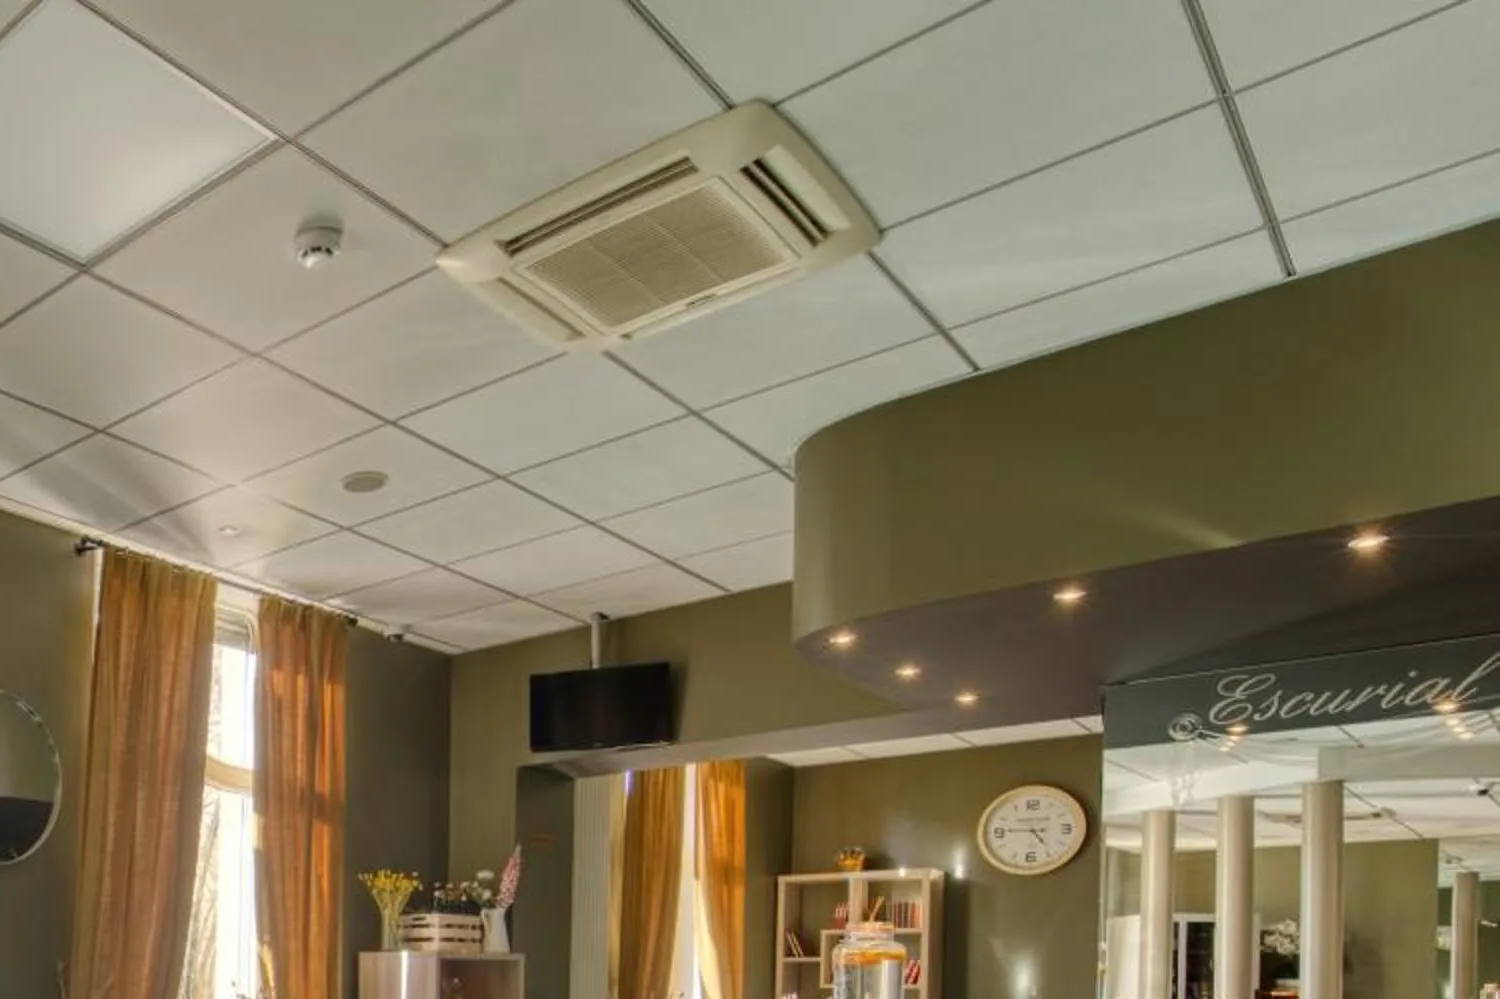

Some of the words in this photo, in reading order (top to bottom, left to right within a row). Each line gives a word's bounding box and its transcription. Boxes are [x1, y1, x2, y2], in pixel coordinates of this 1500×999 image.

[1208, 652, 1500, 725] Escurial
[994, 827, 1005, 839] 9
[1060, 823, 1073, 835] 3
[1025, 851, 1037, 863] 6
